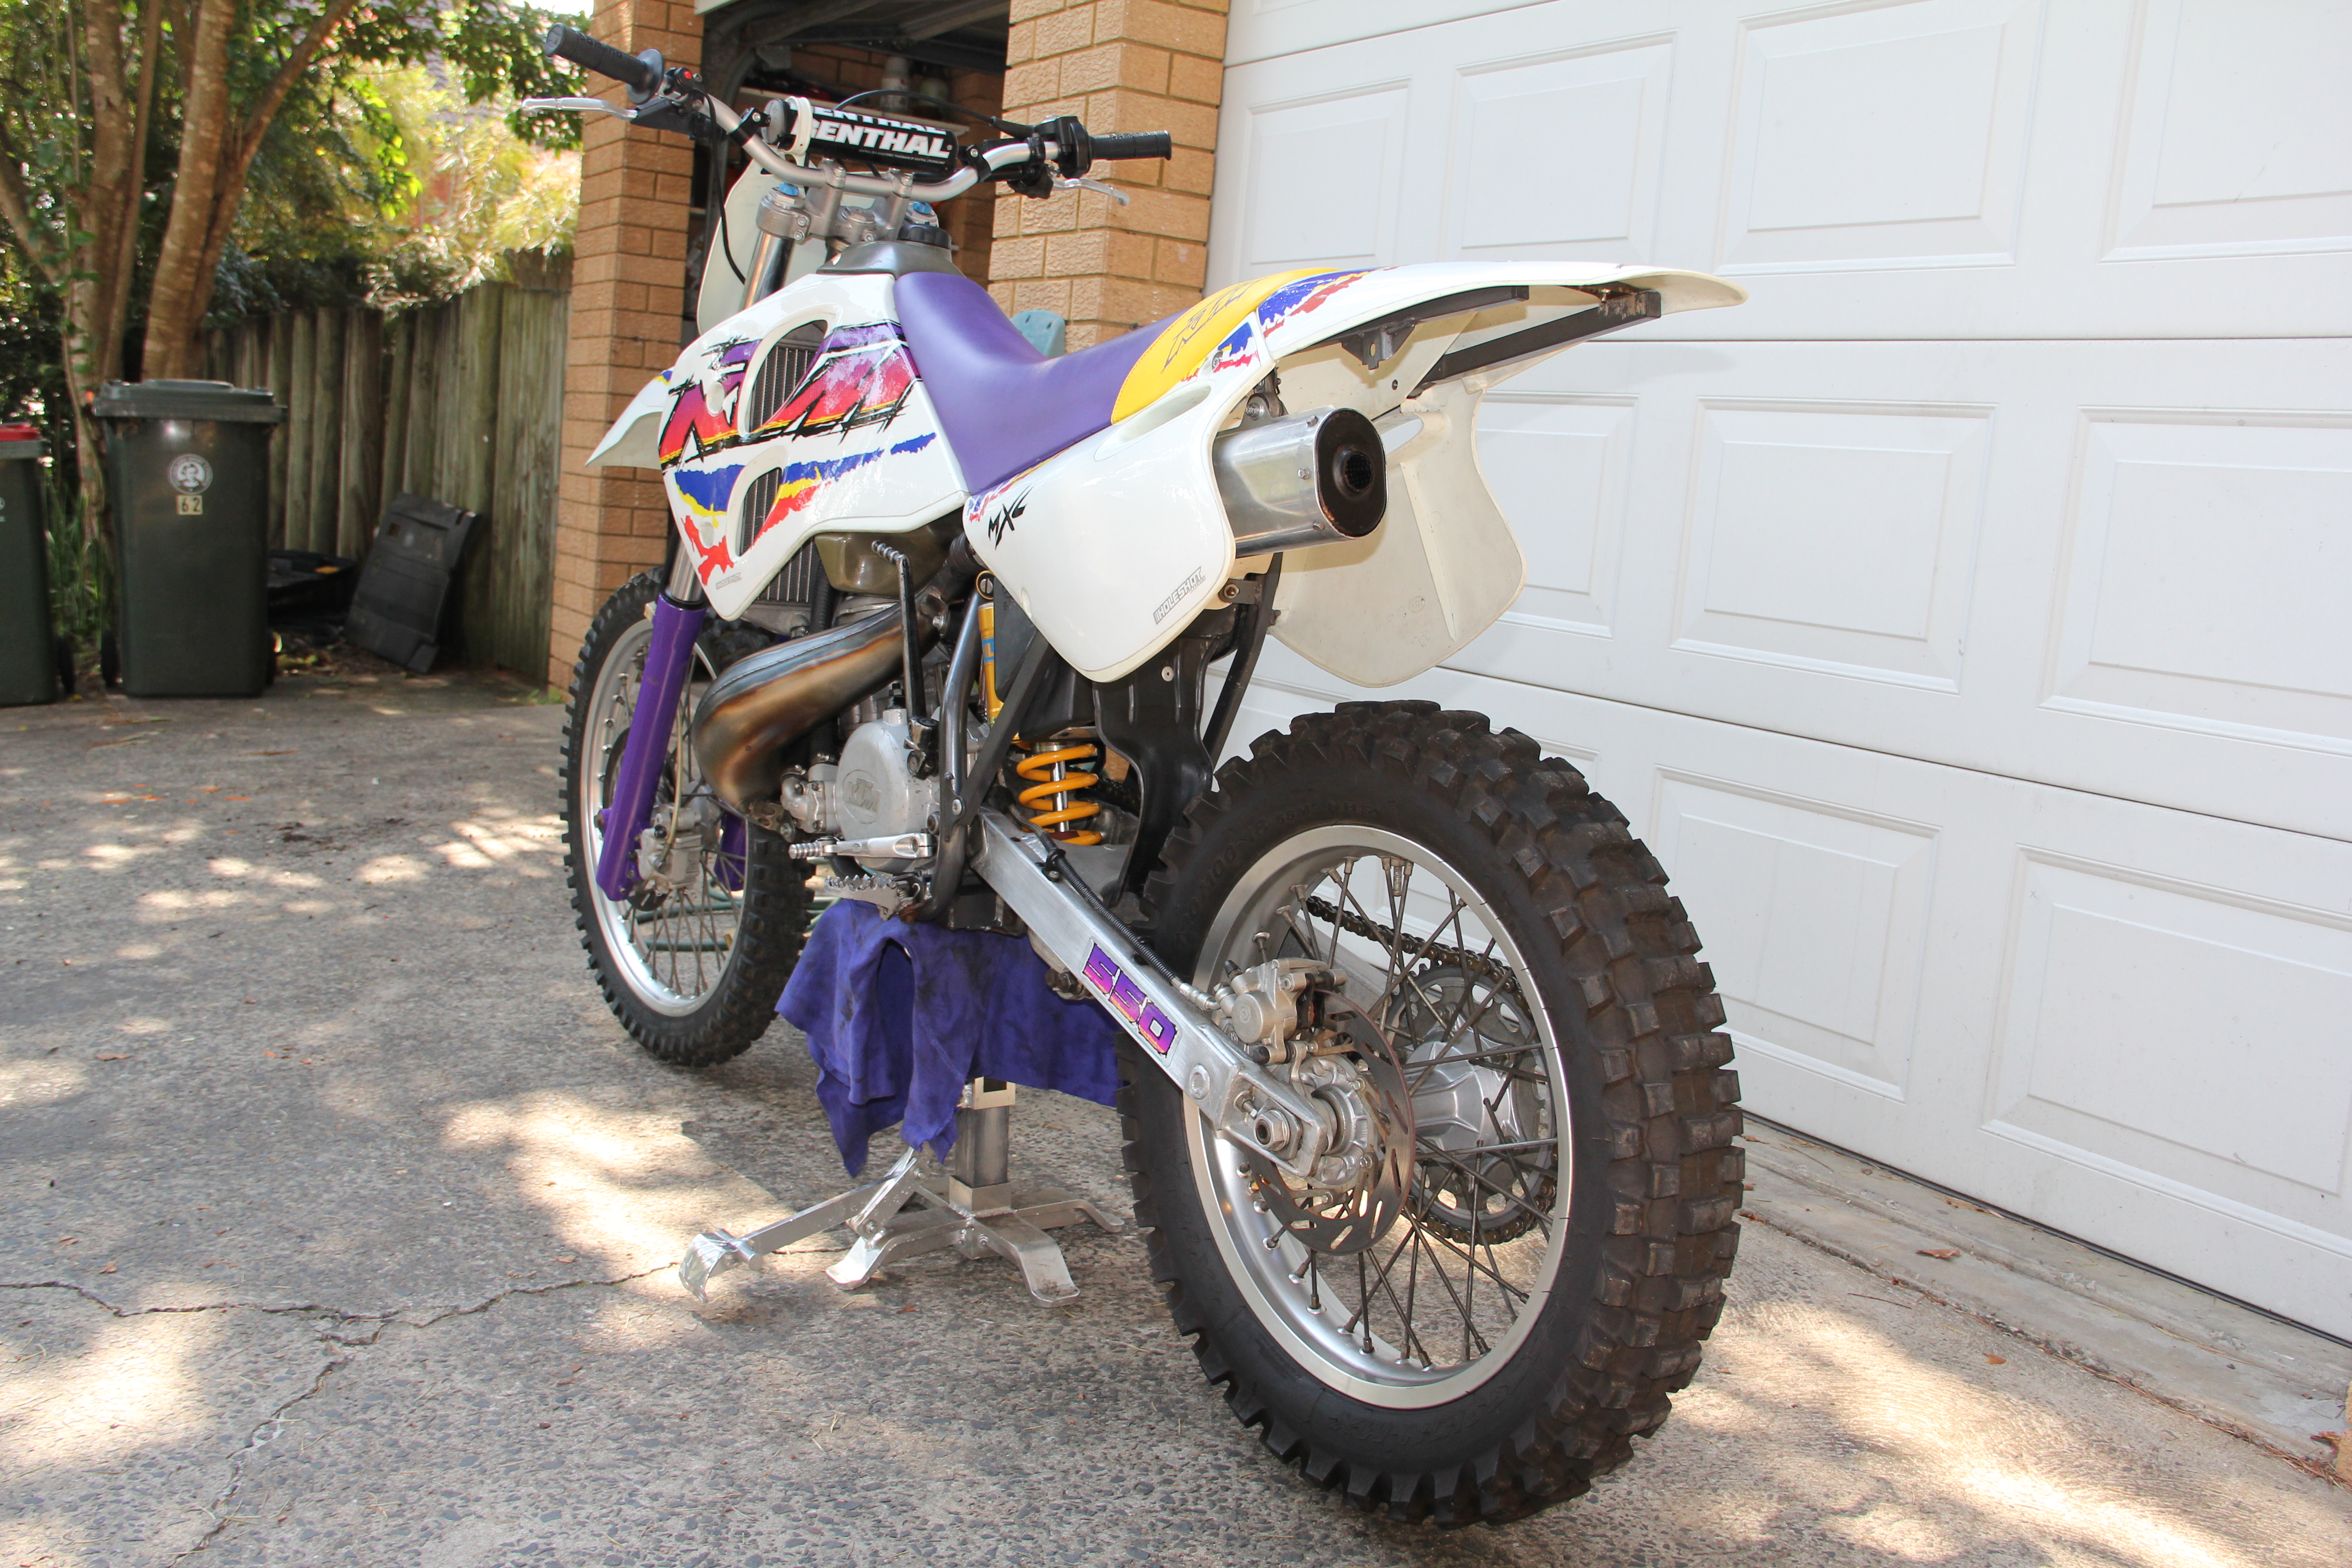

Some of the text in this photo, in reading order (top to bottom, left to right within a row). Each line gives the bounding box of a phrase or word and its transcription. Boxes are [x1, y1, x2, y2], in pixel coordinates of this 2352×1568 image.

[182, 497, 201, 512] 62
[988, 483, 1034, 550] MXC
[1153, 566, 1201, 625] HOLESHOT
[843, 778, 881, 813] KTM
[1082, 941, 1178, 1058] 550
